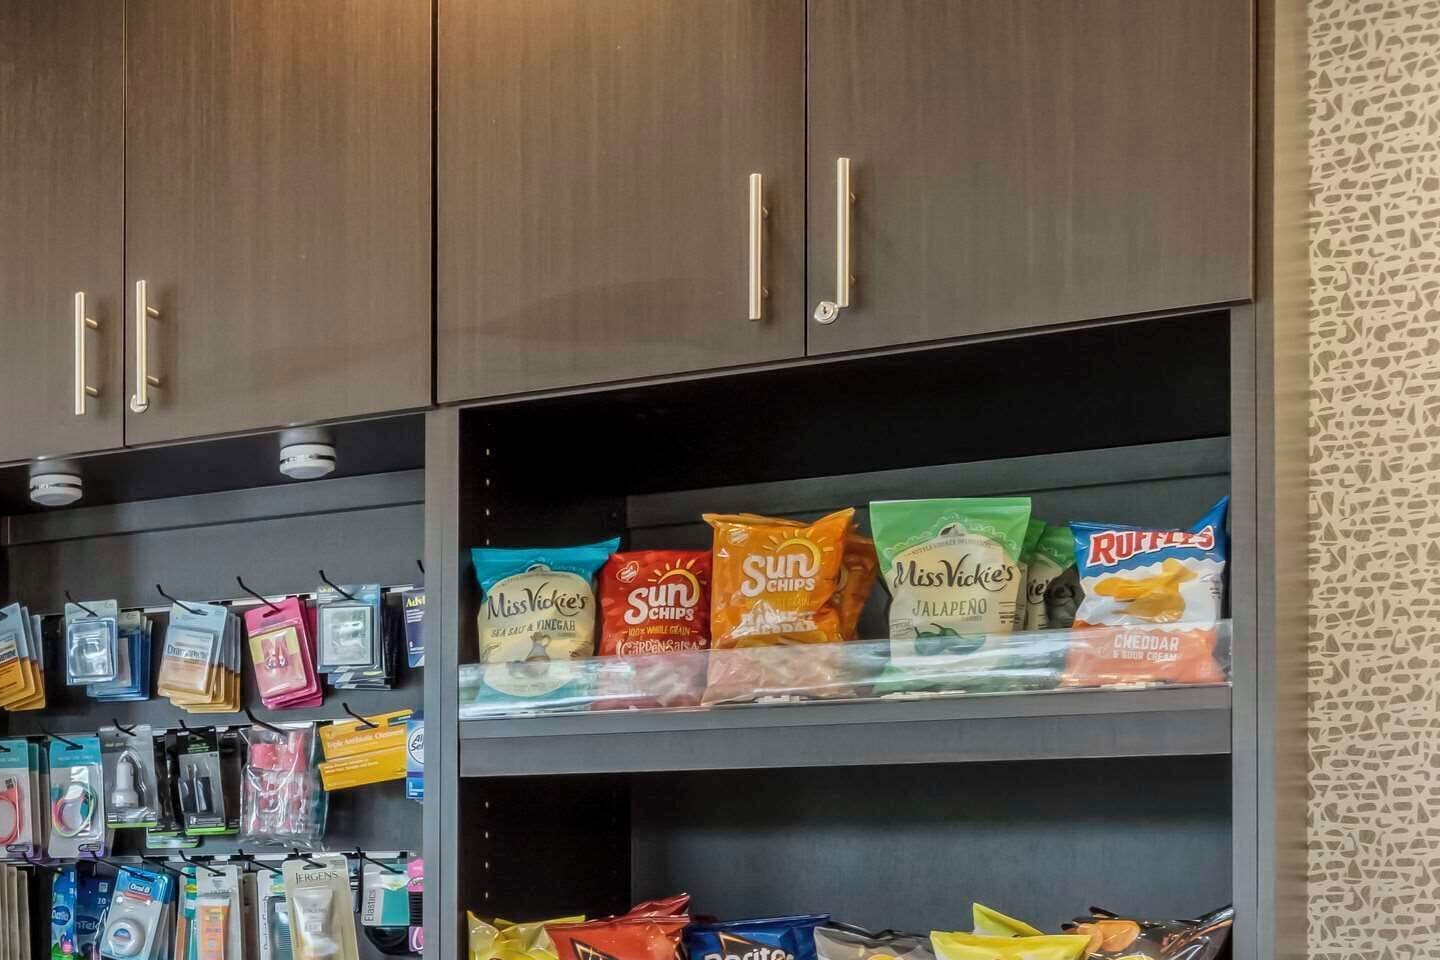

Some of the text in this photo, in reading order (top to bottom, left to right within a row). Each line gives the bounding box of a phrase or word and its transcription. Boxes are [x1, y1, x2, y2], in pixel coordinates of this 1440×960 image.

[741, 553, 820, 598] Sun
[767, 577, 816, 592] CHIPS
[893, 561, 942, 588] Miss
[938, 553, 1013, 592] Vickie's
[487, 592, 527, 620] Miss
[624, 583, 698, 625] Sun
[648, 607, 695, 621] CHIPS
[912, 598, 988, 617] JALAPEÑO
[296, 871, 339, 885] JERGENS
[364, 889, 377, 922] Elastics
